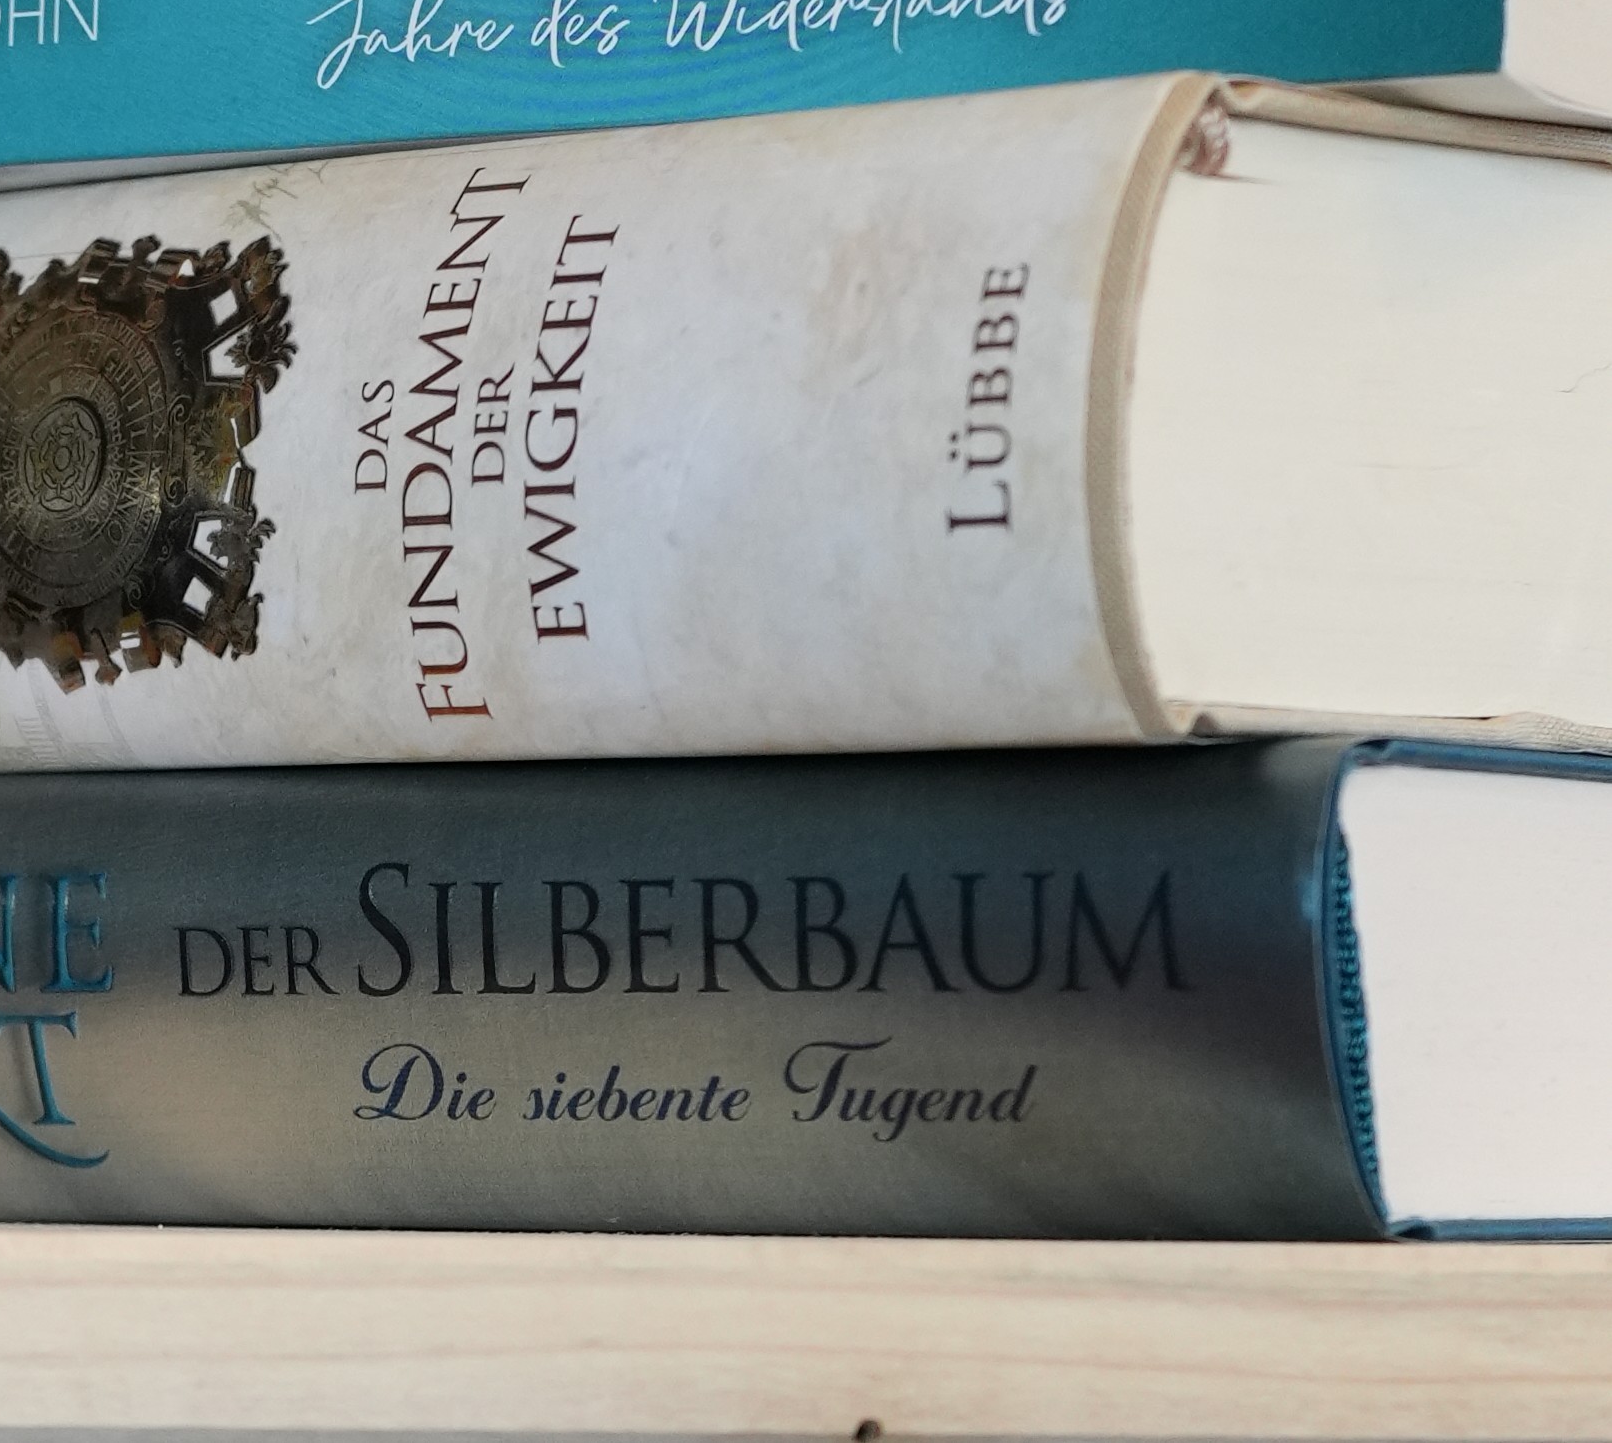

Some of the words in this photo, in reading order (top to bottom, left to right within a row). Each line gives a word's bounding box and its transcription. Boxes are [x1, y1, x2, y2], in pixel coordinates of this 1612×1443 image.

[353, 378, 396, 496] DAS
[401, 166, 532, 724] FUNDAMENT
[470, 361, 516, 488] DER
[522, 214, 621, 646] EWIGKEIT
[945, 262, 1030, 536] LÜBBE
[175, 924, 342, 999] DER
[355, 860, 1195, 998] SILBERBAUM
[351, 1041, 499, 1124] Die
[521, 1063, 752, 1125] siebente
[781, 1034, 1038, 1143] Tugend
